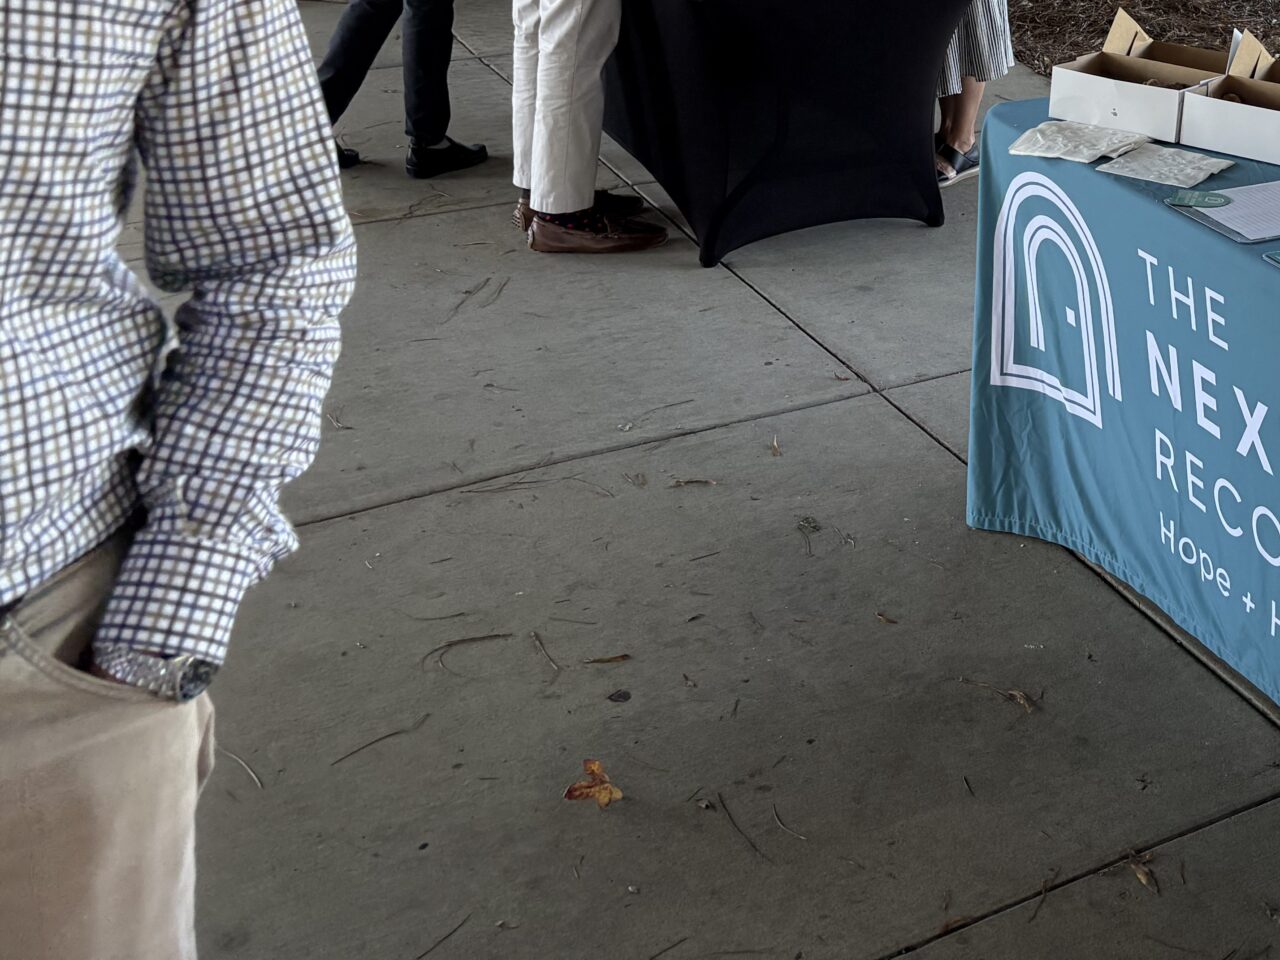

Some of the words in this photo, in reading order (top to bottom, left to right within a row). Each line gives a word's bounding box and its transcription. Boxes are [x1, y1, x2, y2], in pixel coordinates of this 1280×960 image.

[1137, 248, 1229, 351] THE
[1159, 511, 1231, 598] Hope
[1242, 592, 1256, 614] +
